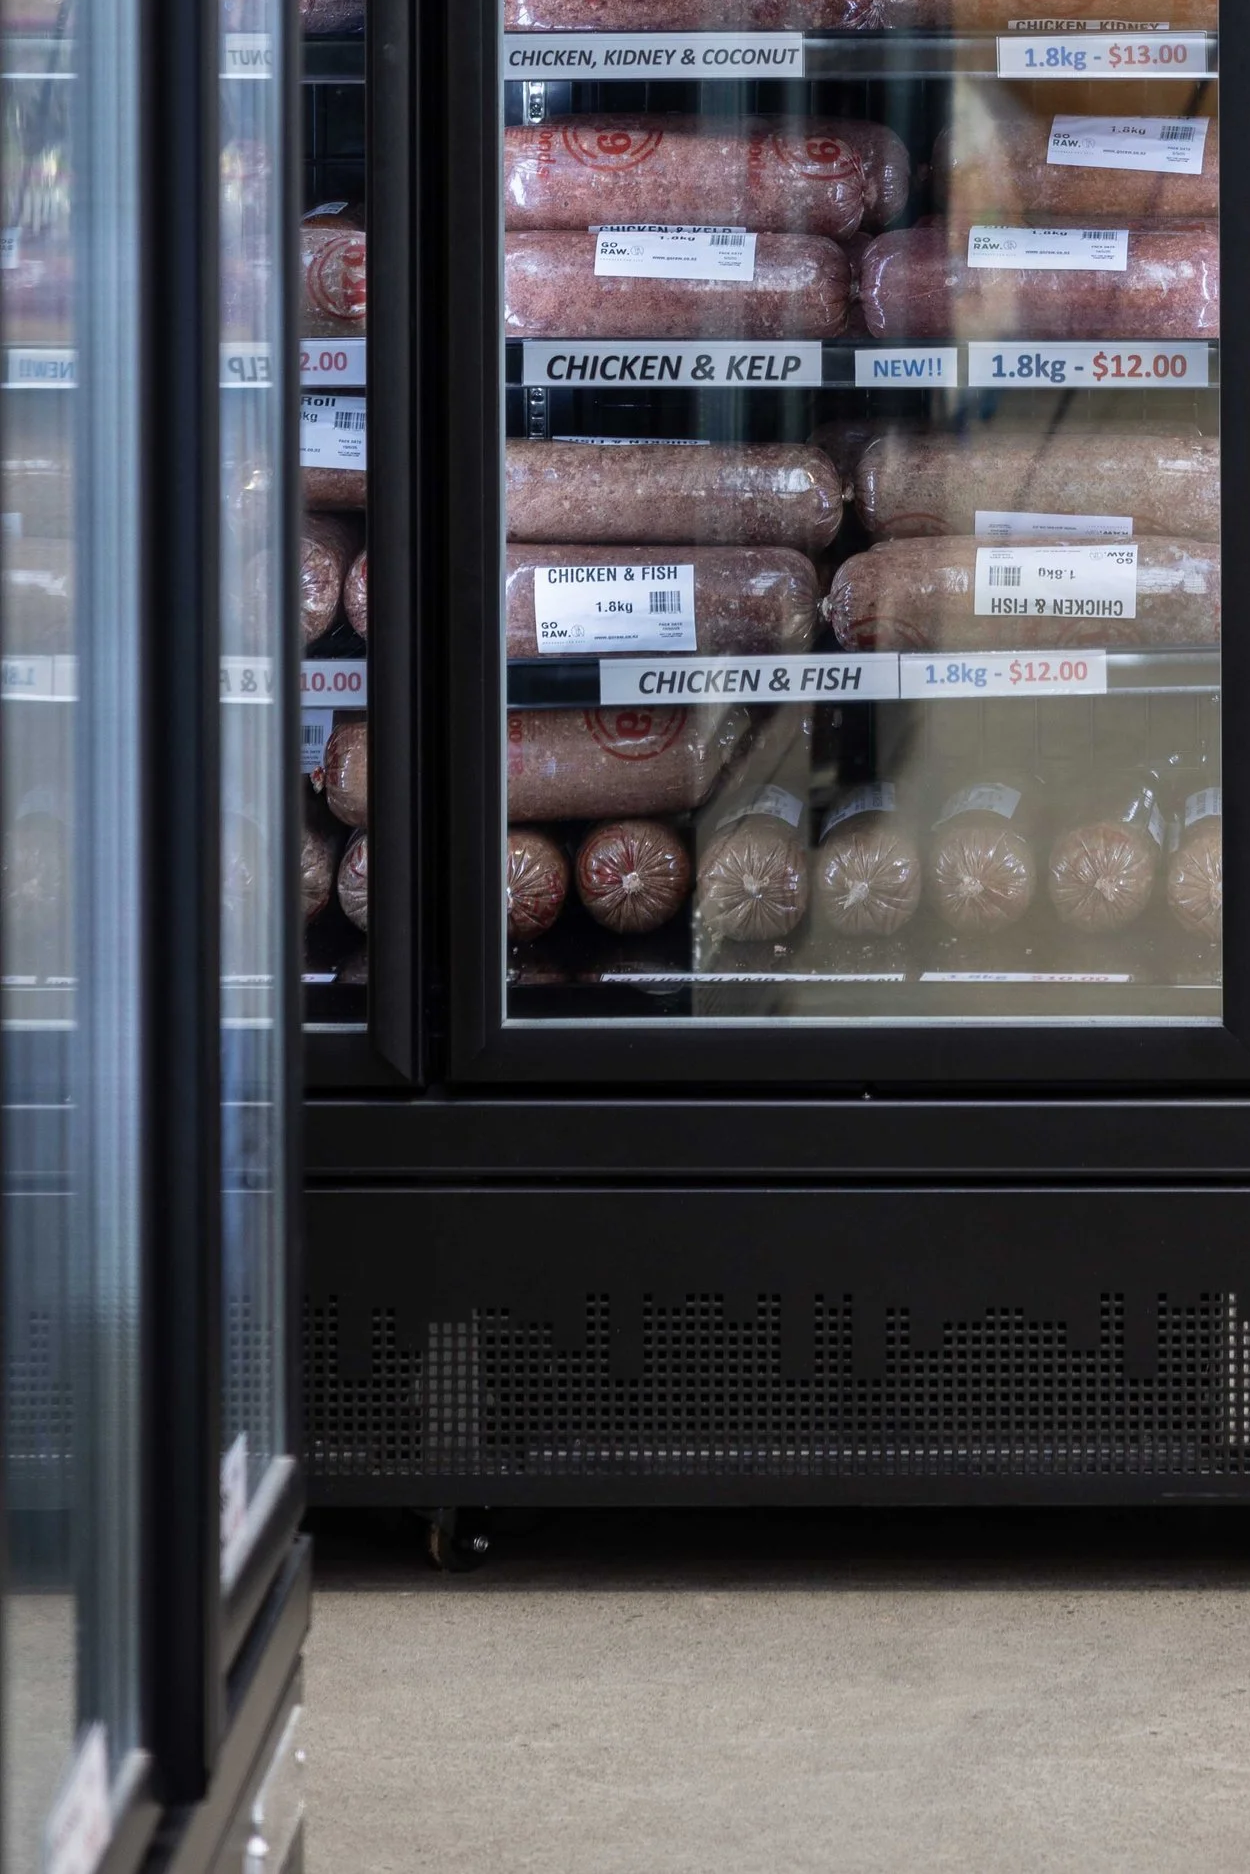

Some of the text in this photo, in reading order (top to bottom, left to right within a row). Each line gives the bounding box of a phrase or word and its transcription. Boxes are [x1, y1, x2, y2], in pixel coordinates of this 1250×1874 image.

[509, 47, 799, 70] CHICKEN, KIDNEY & COCONUT
[1025, 46, 1087, 70] 1.8kg
[1108, 43, 1187, 68] $13.00
[1111, 126, 1146, 135] 1.8kg
[1052, 139, 1081, 148] RAW.
[546, 355, 801, 382] CHICKEN & KELP
[873, 357, 942, 378] NEW!!
[991, 353, 1066, 383] 1.8kg
[1092, 351, 1187, 382] $12.00
[548, 566, 677, 583] CHICKEN & FISH
[1039, 567, 1076, 579] 1.8kg
[595, 601, 633, 613] 1.8kg
[991, 597, 1123, 616] CHICKEN & FISH
[542, 630, 571, 638] RAW.
[639, 667, 861, 695] CHICKEN & FISH
[925, 663, 987, 688] 1.8kg
[1008, 659, 1088, 685] $12.00
